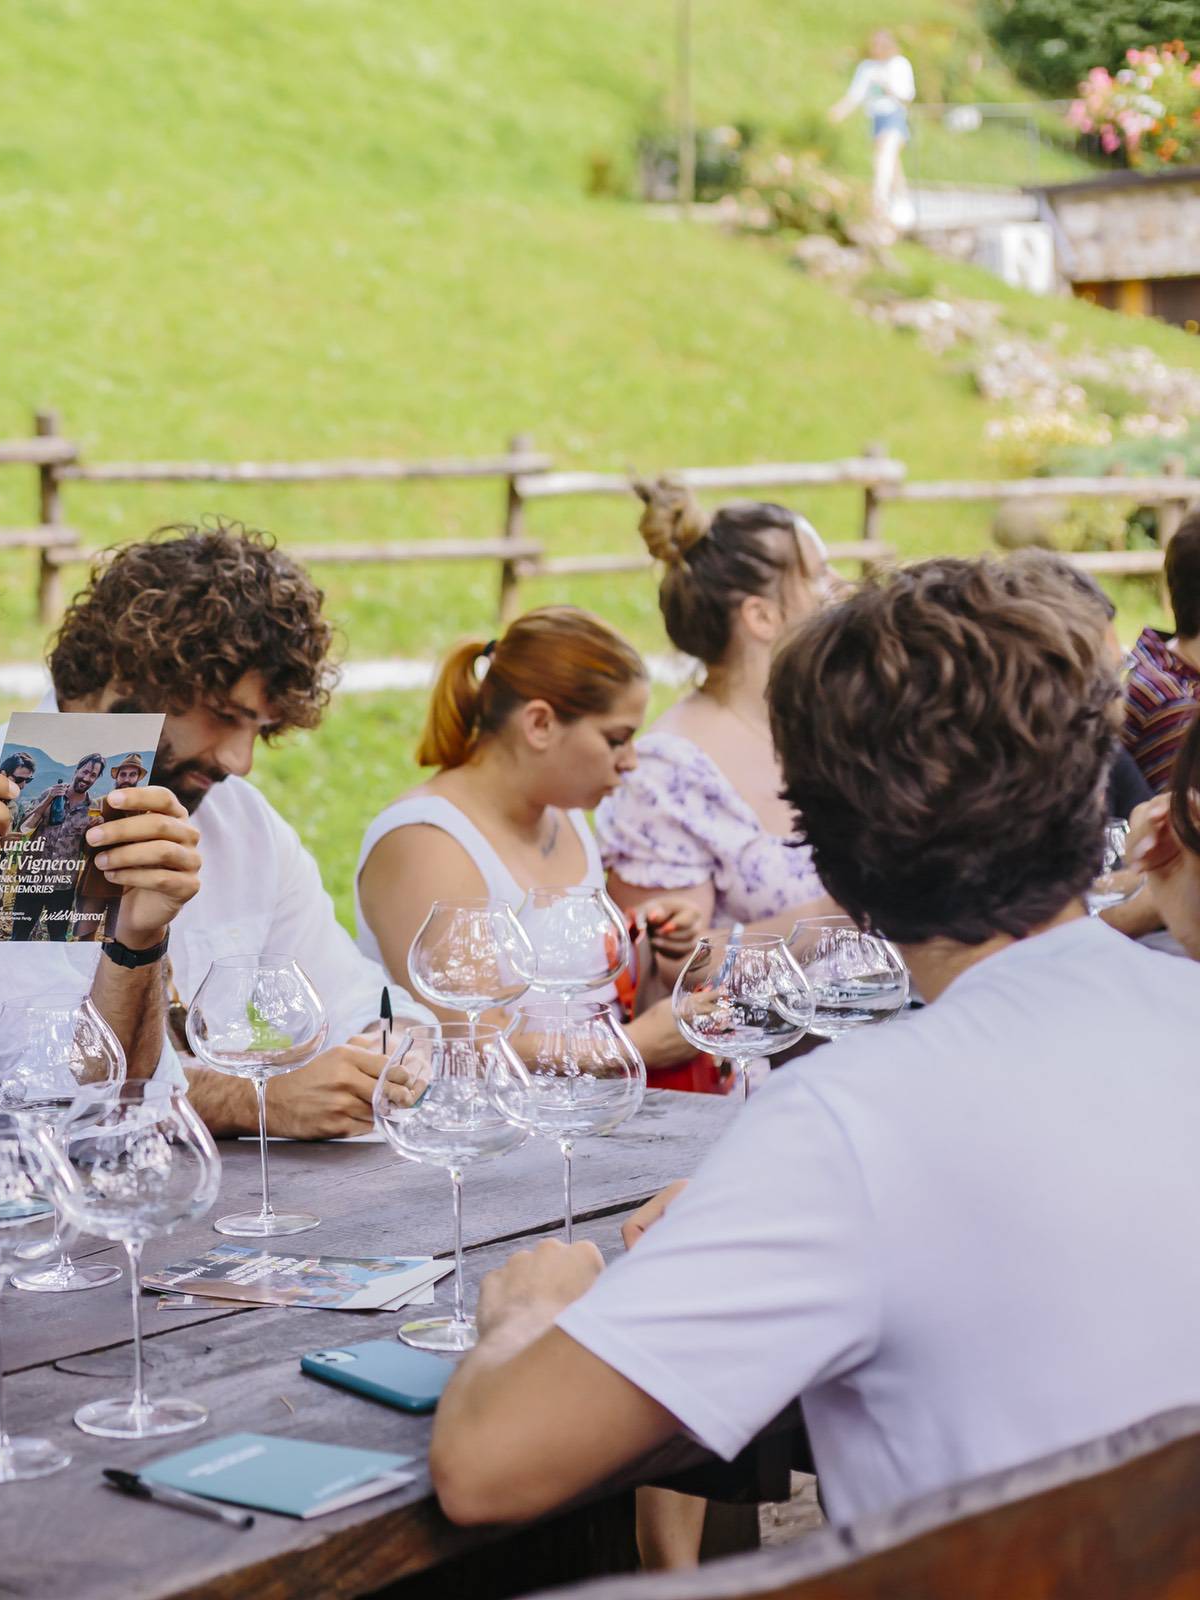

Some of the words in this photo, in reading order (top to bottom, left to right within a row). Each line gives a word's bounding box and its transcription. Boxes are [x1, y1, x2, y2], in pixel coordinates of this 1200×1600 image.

[0, 836, 46, 852] unedì
[17, 855, 86, 874] Vigneron
[13, 875, 43, 883] (WILD)
[44, 875, 72, 884] WINES,
[10, 885, 54, 893] MEMORIES
